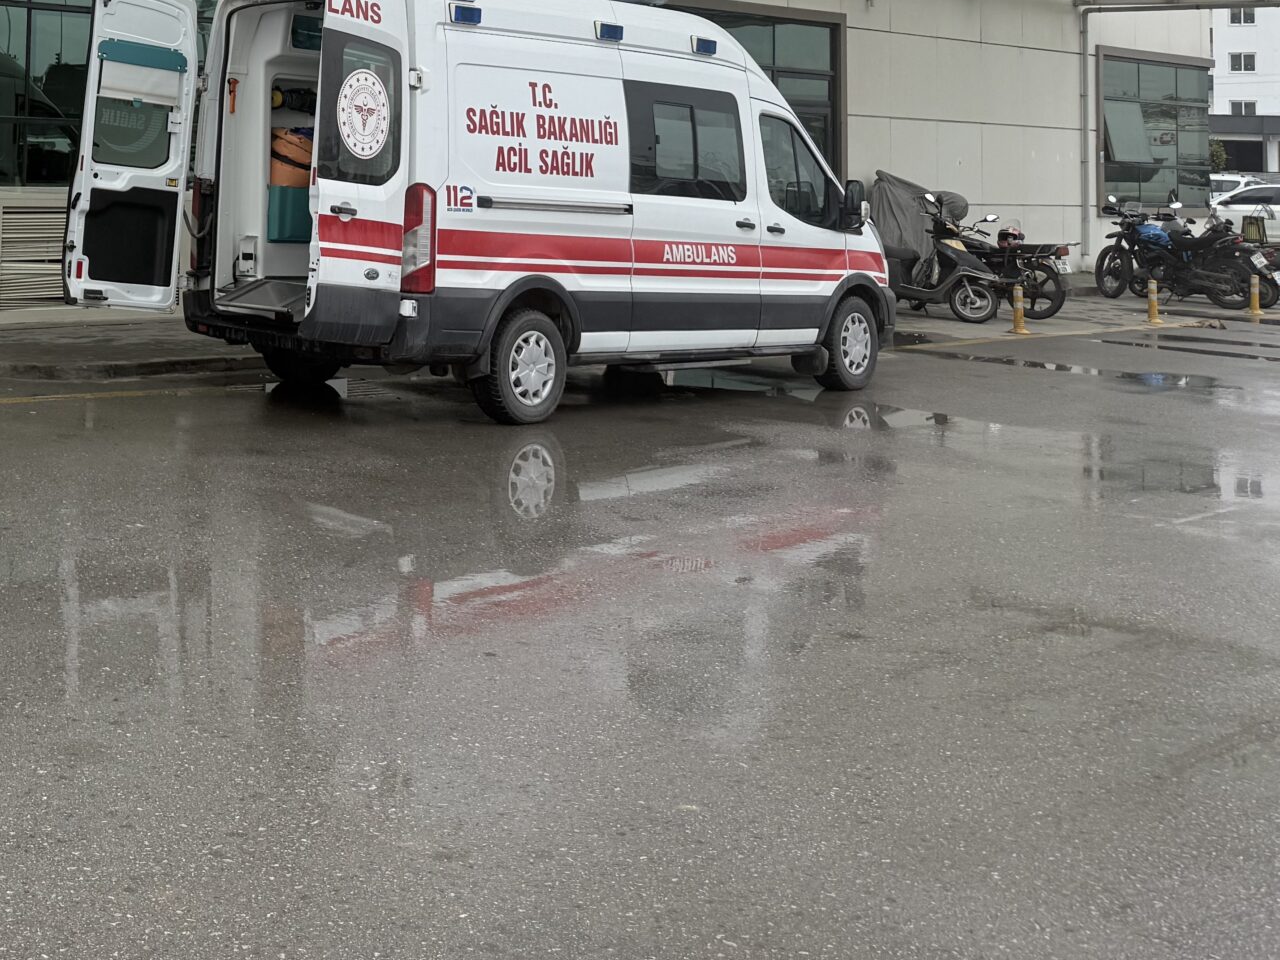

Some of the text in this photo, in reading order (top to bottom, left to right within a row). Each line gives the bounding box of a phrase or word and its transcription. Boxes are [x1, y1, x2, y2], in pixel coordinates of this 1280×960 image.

[528, 81, 559, 109] T.C.
[465, 104, 619, 146] SAĞLIK BAKANLIĞI
[495, 142, 595, 178] ACİL SAĞLIK
[445, 184, 474, 208] 112
[662, 243, 738, 265] AMBULANS
